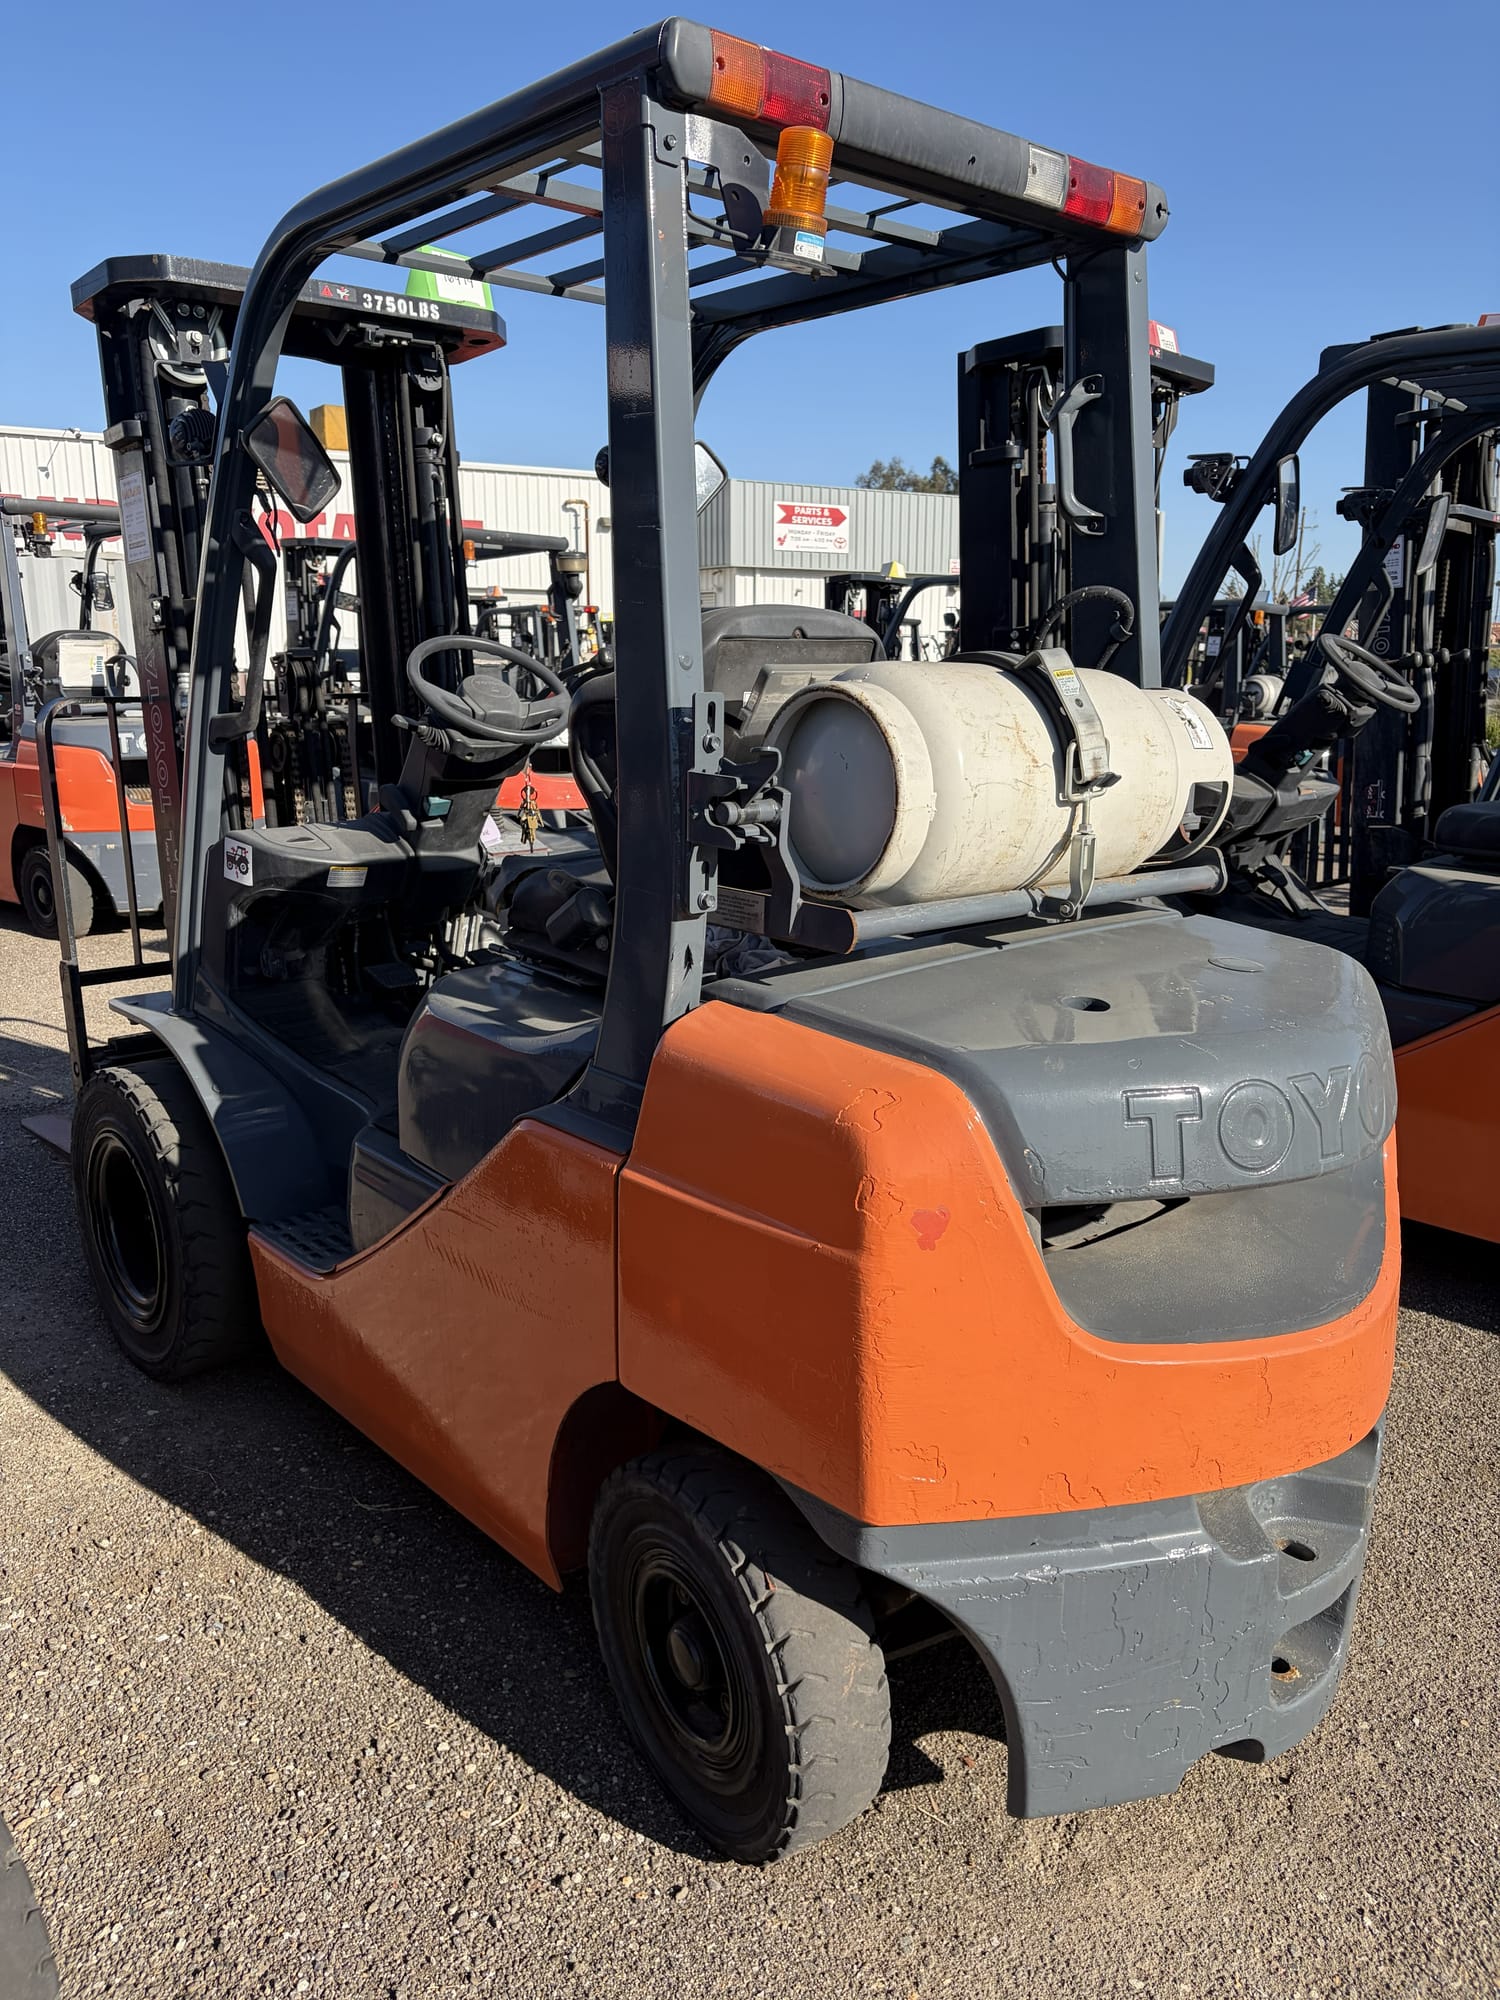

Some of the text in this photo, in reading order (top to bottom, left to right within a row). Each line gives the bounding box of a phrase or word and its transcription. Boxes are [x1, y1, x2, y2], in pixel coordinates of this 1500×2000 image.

[362, 293, 440, 320] 3750LBS
[791, 515, 832, 525] SERVICES
[794, 506, 830, 516] PARTS &
[144, 647, 174, 814] TOYOTA
